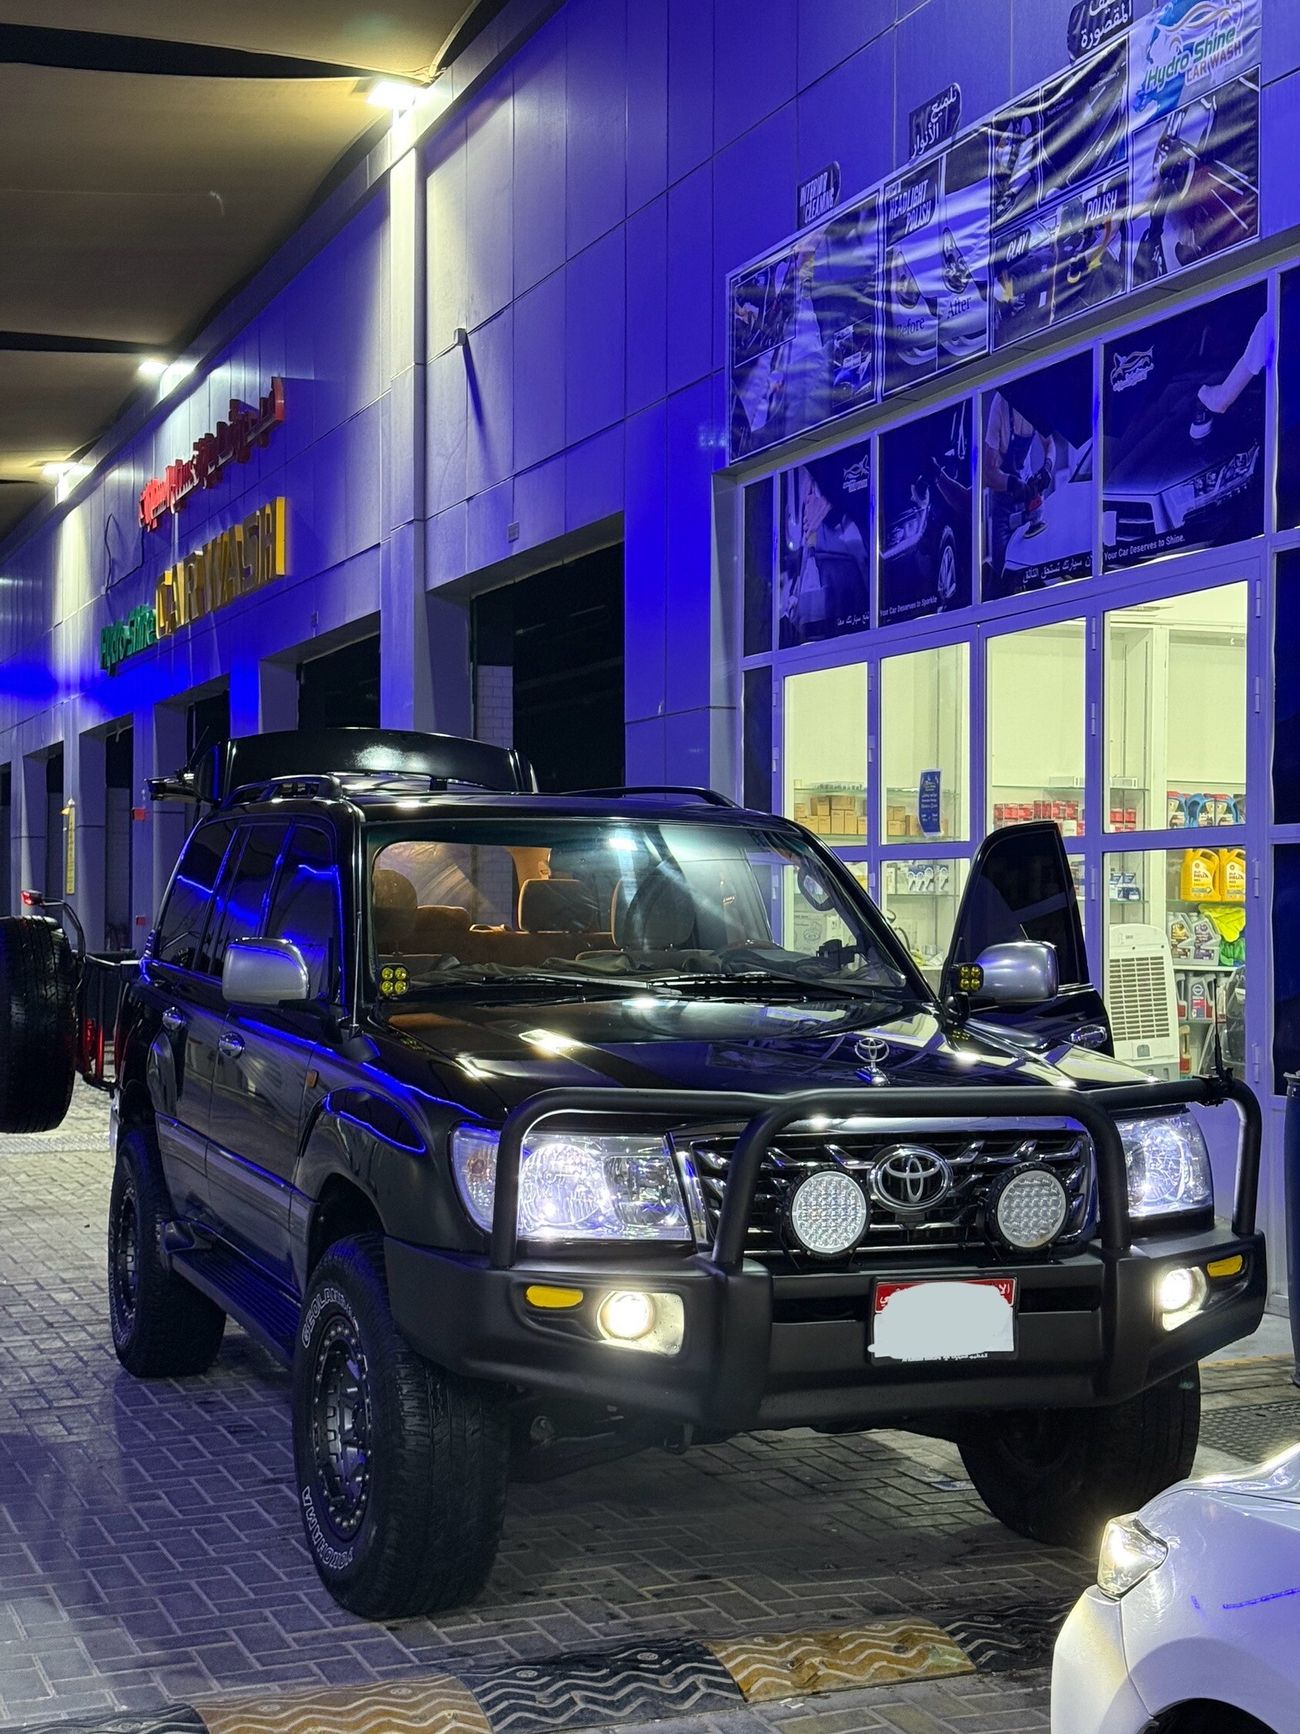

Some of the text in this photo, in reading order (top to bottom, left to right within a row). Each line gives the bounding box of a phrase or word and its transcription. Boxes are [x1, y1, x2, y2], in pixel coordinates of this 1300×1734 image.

[1081, 0, 1131, 49] المقصورة
[1144, 53, 1190, 87] Hydro
[1193, 27, 1236, 63] Shine
[1186, 40, 1242, 81] CAR WASH
[911, 122, 939, 158] الأنوار
[889, 179, 928, 222] HEADLIGHT
[905, 199, 932, 234] POLISH
[1084, 189, 1118, 223] POLISH
[1006, 231, 1029, 262] CLAY
[946, 296, 972, 319] After
[896, 317, 925, 337] Before
[1103, 551, 1118, 561] Your
[1118, 547, 1129, 558] Car
[1129, 541, 1158, 555] Deserves
[1158, 539, 1165, 548] to
[889, 606, 897, 615] Car
